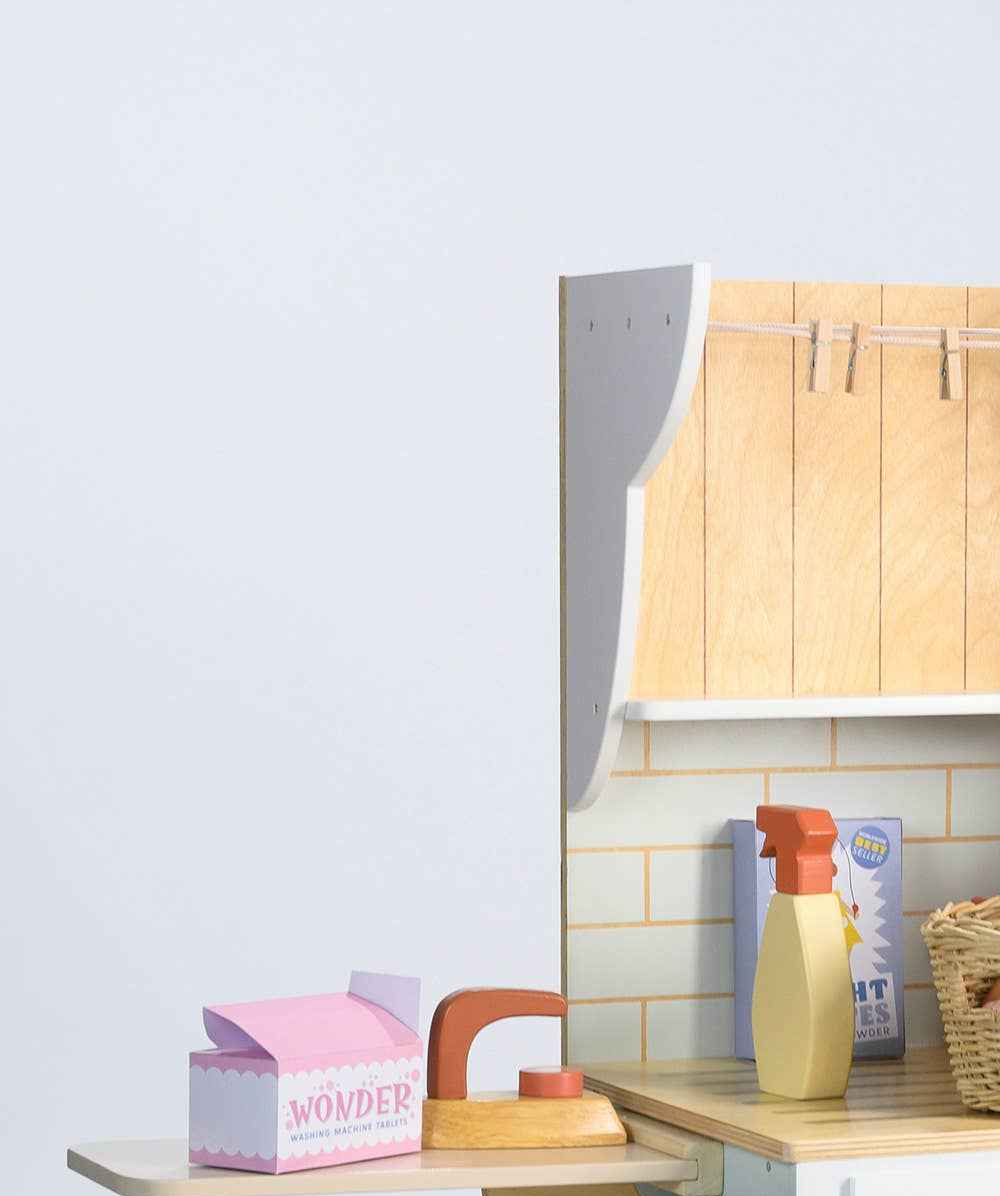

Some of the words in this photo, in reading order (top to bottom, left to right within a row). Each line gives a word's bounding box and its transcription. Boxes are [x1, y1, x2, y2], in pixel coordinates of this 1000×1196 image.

[857, 1026, 890, 1039] WDER
[289, 1083, 413, 1128] WONDER
[290, 1127, 331, 1143] WASHING
[334, 1122, 373, 1136] MACHINE
[376, 1118, 408, 1130] TABLETS
